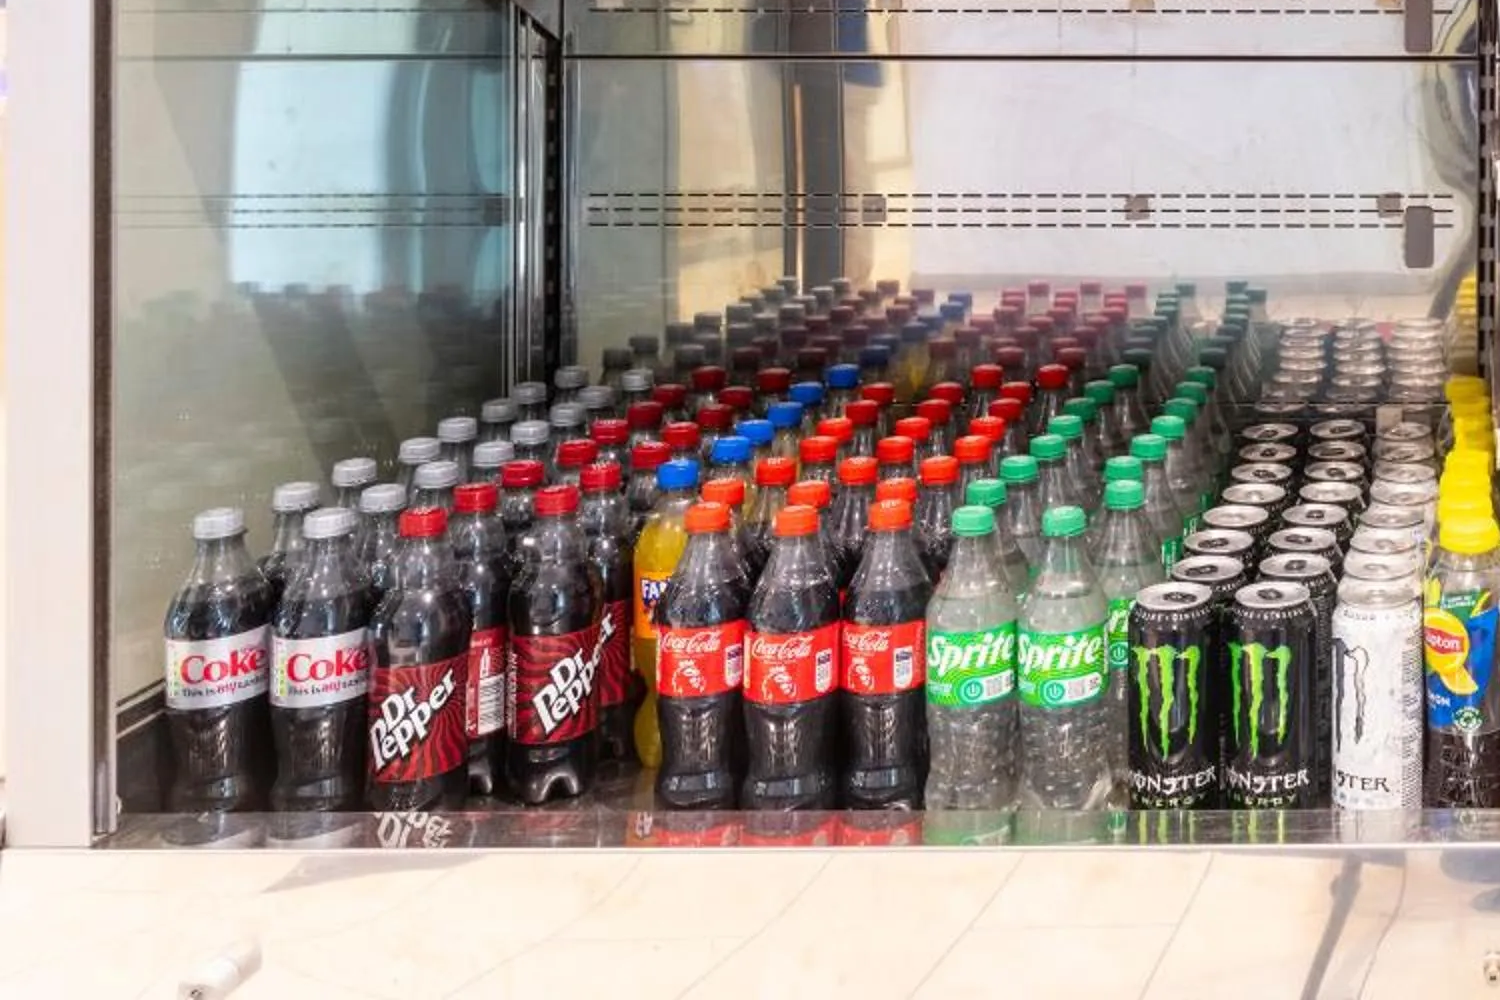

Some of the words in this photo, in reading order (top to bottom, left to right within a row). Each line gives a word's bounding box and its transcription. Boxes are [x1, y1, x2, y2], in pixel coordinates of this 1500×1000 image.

[662, 630, 722, 654] Coca-Cola
[750, 634, 815, 659] Coca-Cola
[843, 630, 889, 652] Coca-Cola
[928, 632, 1014, 679] Sprite
[1018, 632, 1101, 680] Sprite
[180, 649, 265, 685] Coke
[287, 648, 369, 683] Coke
[550, 648, 584, 692] Dr
[182, 688, 204, 697] This
[205, 687, 214, 696] is
[288, 688, 310, 696] This
[311, 686, 320, 695] is
[381, 686, 417, 725] Dr
[370, 668, 457, 770] Pepper
